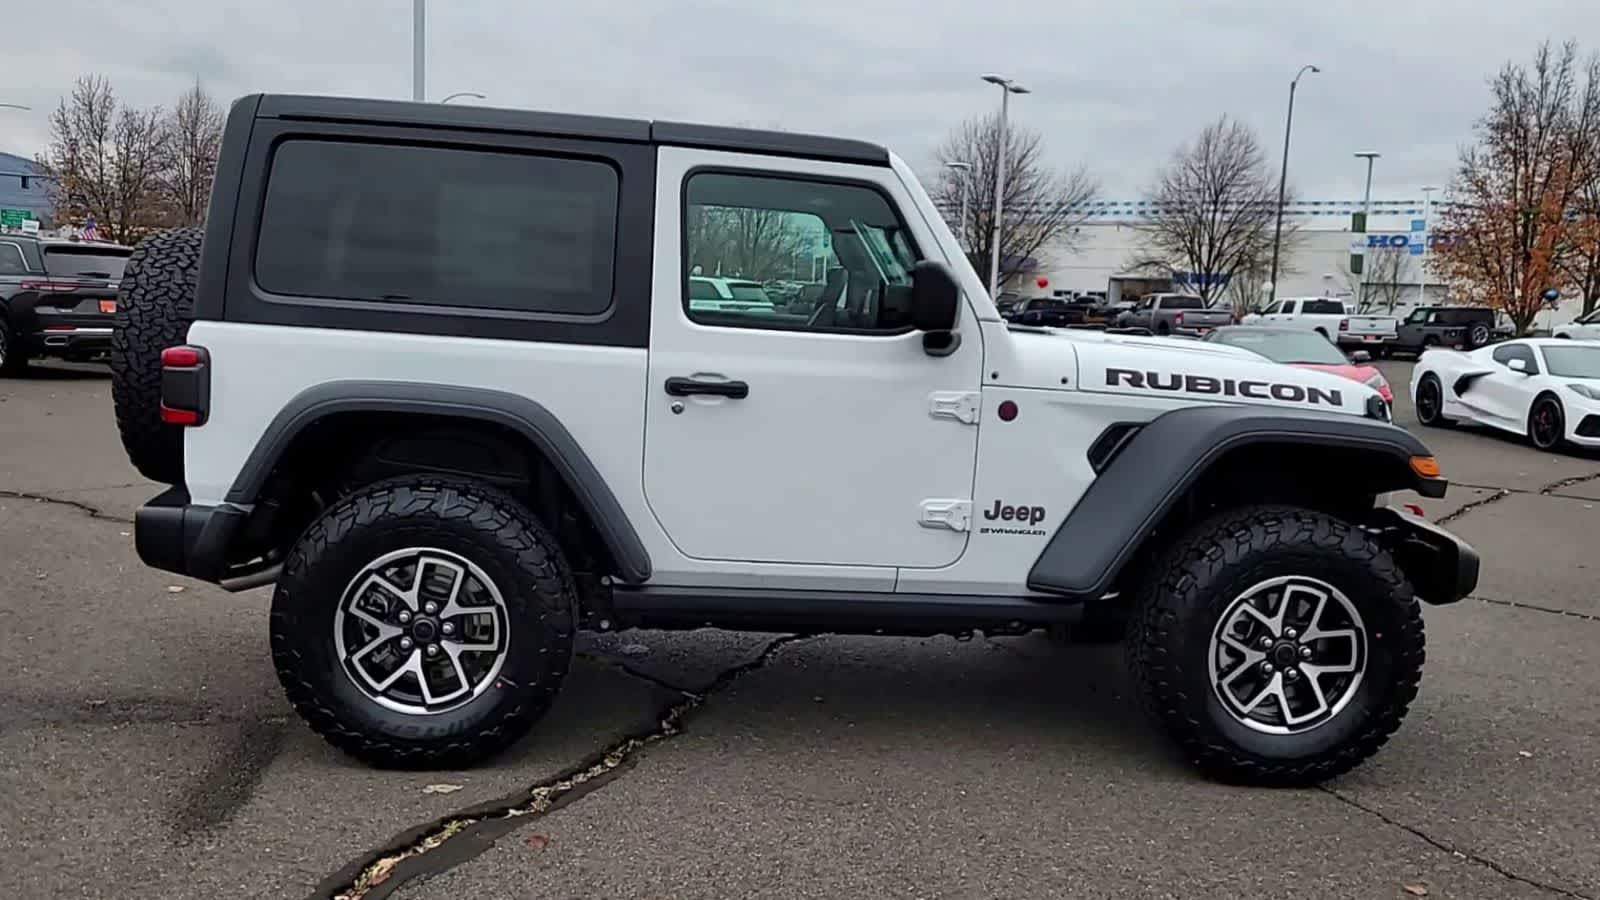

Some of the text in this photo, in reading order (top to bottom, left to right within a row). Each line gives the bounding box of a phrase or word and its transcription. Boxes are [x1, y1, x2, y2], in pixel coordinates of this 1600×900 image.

[1367, 235, 1466, 248] HOD
[1106, 368, 1343, 406] RUBICON
[984, 499, 1046, 526] Jeep
[989, 528, 1046, 536] WRANGLER
